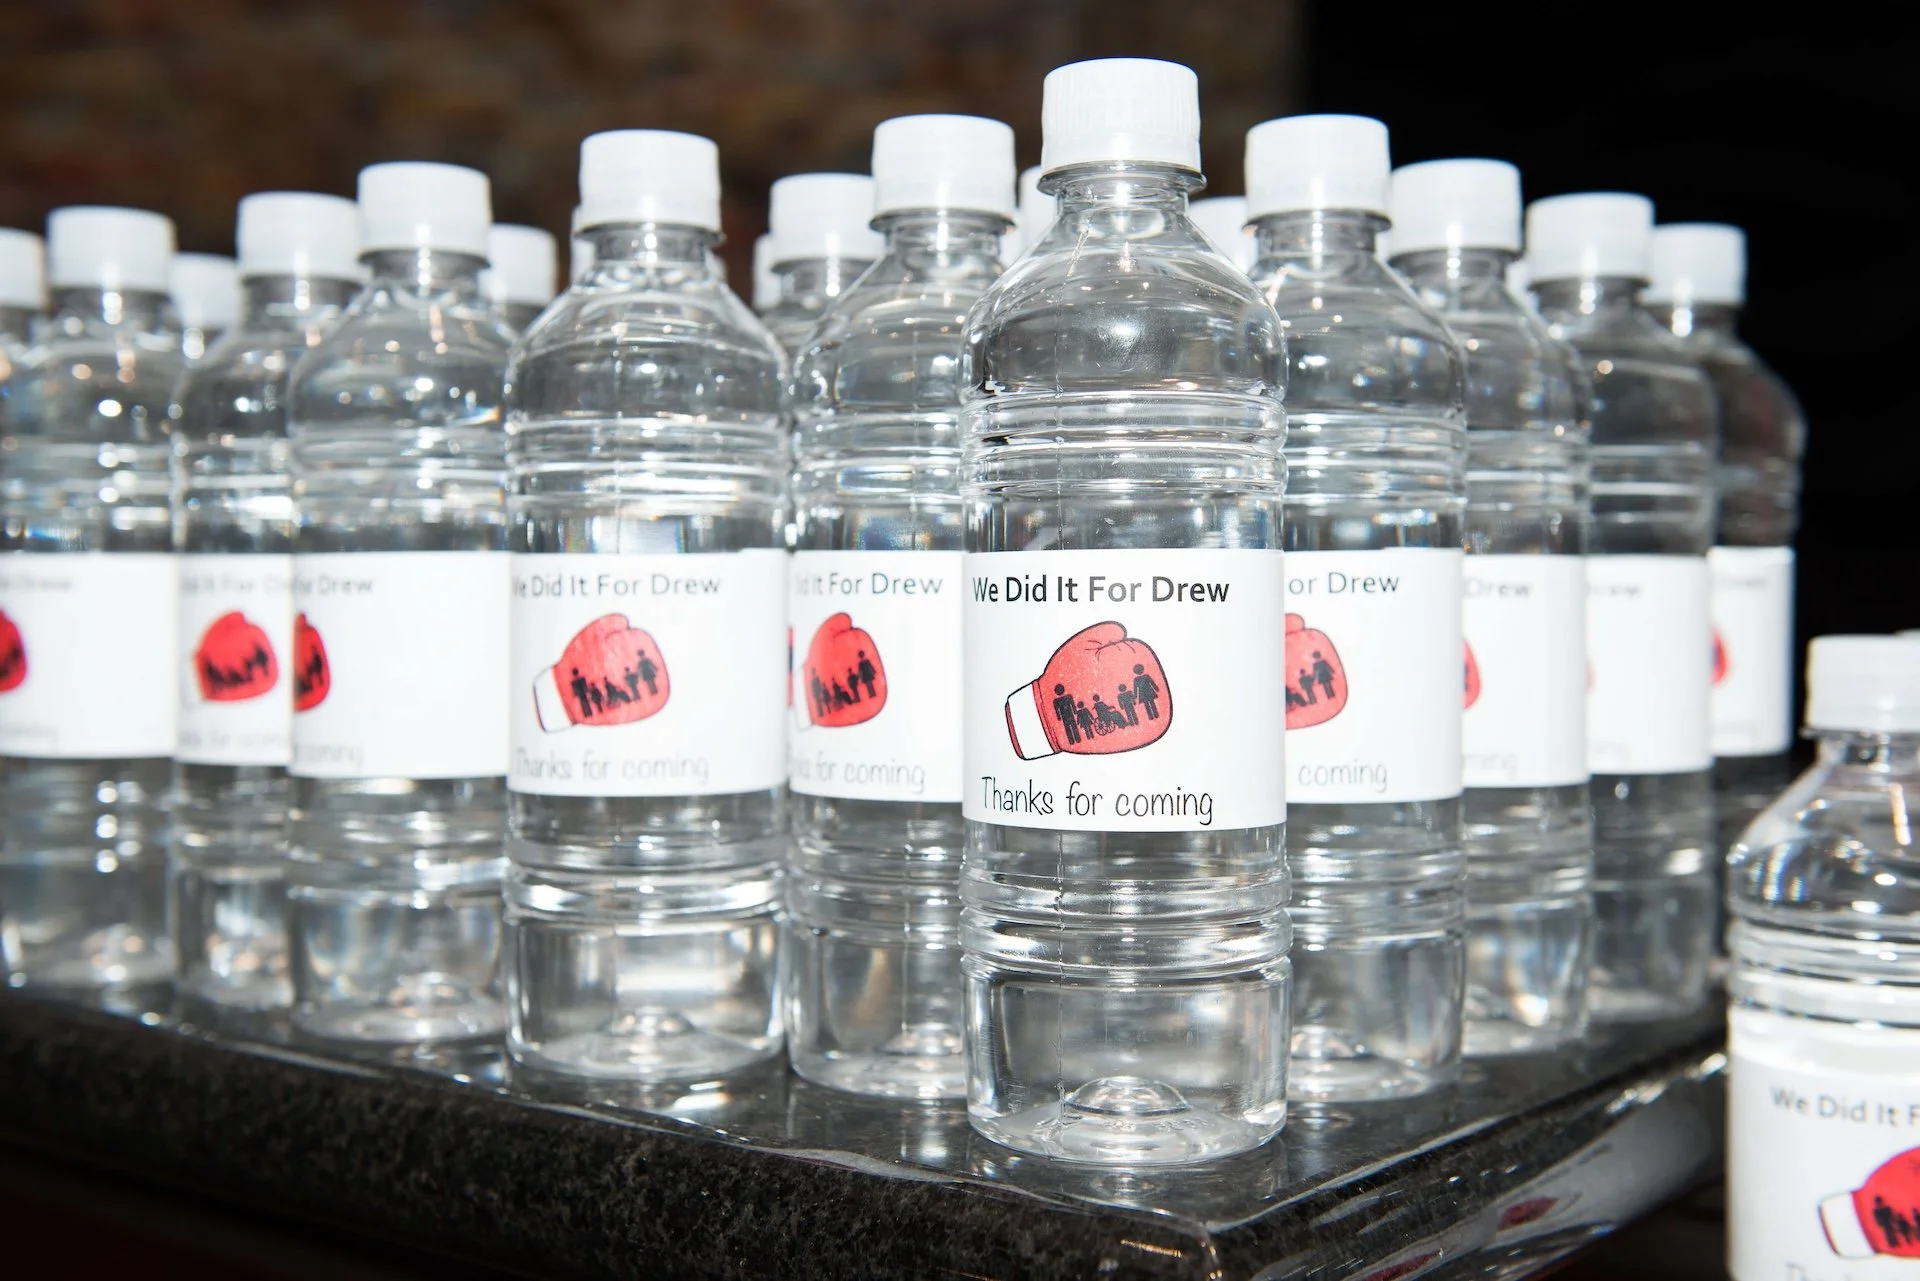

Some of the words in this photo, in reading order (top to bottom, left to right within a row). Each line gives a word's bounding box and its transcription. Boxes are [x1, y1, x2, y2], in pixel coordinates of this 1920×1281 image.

[531, 573, 562, 597] Did
[571, 575, 588, 597] It
[597, 573, 641, 597] For
[651, 573, 722, 596] Drew
[829, 572, 863, 595] For
[872, 572, 944, 595] Drew
[972, 576, 999, 603] We
[1006, 574, 1047, 603] Did
[1057, 576, 1078, 603] It
[1089, 575, 1142, 603] For
[1152, 575, 1230, 603] Drew
[1288, 575, 1318, 595] or
[1328, 571, 1400, 595] Drew
[516, 746, 573, 779] Thanks
[582, 748, 611, 780] for
[622, 751, 710, 786] coming
[843, 757, 926, 794] coming
[1298, 757, 1388, 793] coming
[981, 776, 1055, 816] Thanks
[1065, 780, 1104, 816] for
[1115, 786, 1214, 826] coming
[1770, 1084, 1810, 1116] We
[1818, 1092, 1867, 1124] Did
[1877, 1102, 1900, 1127] It
